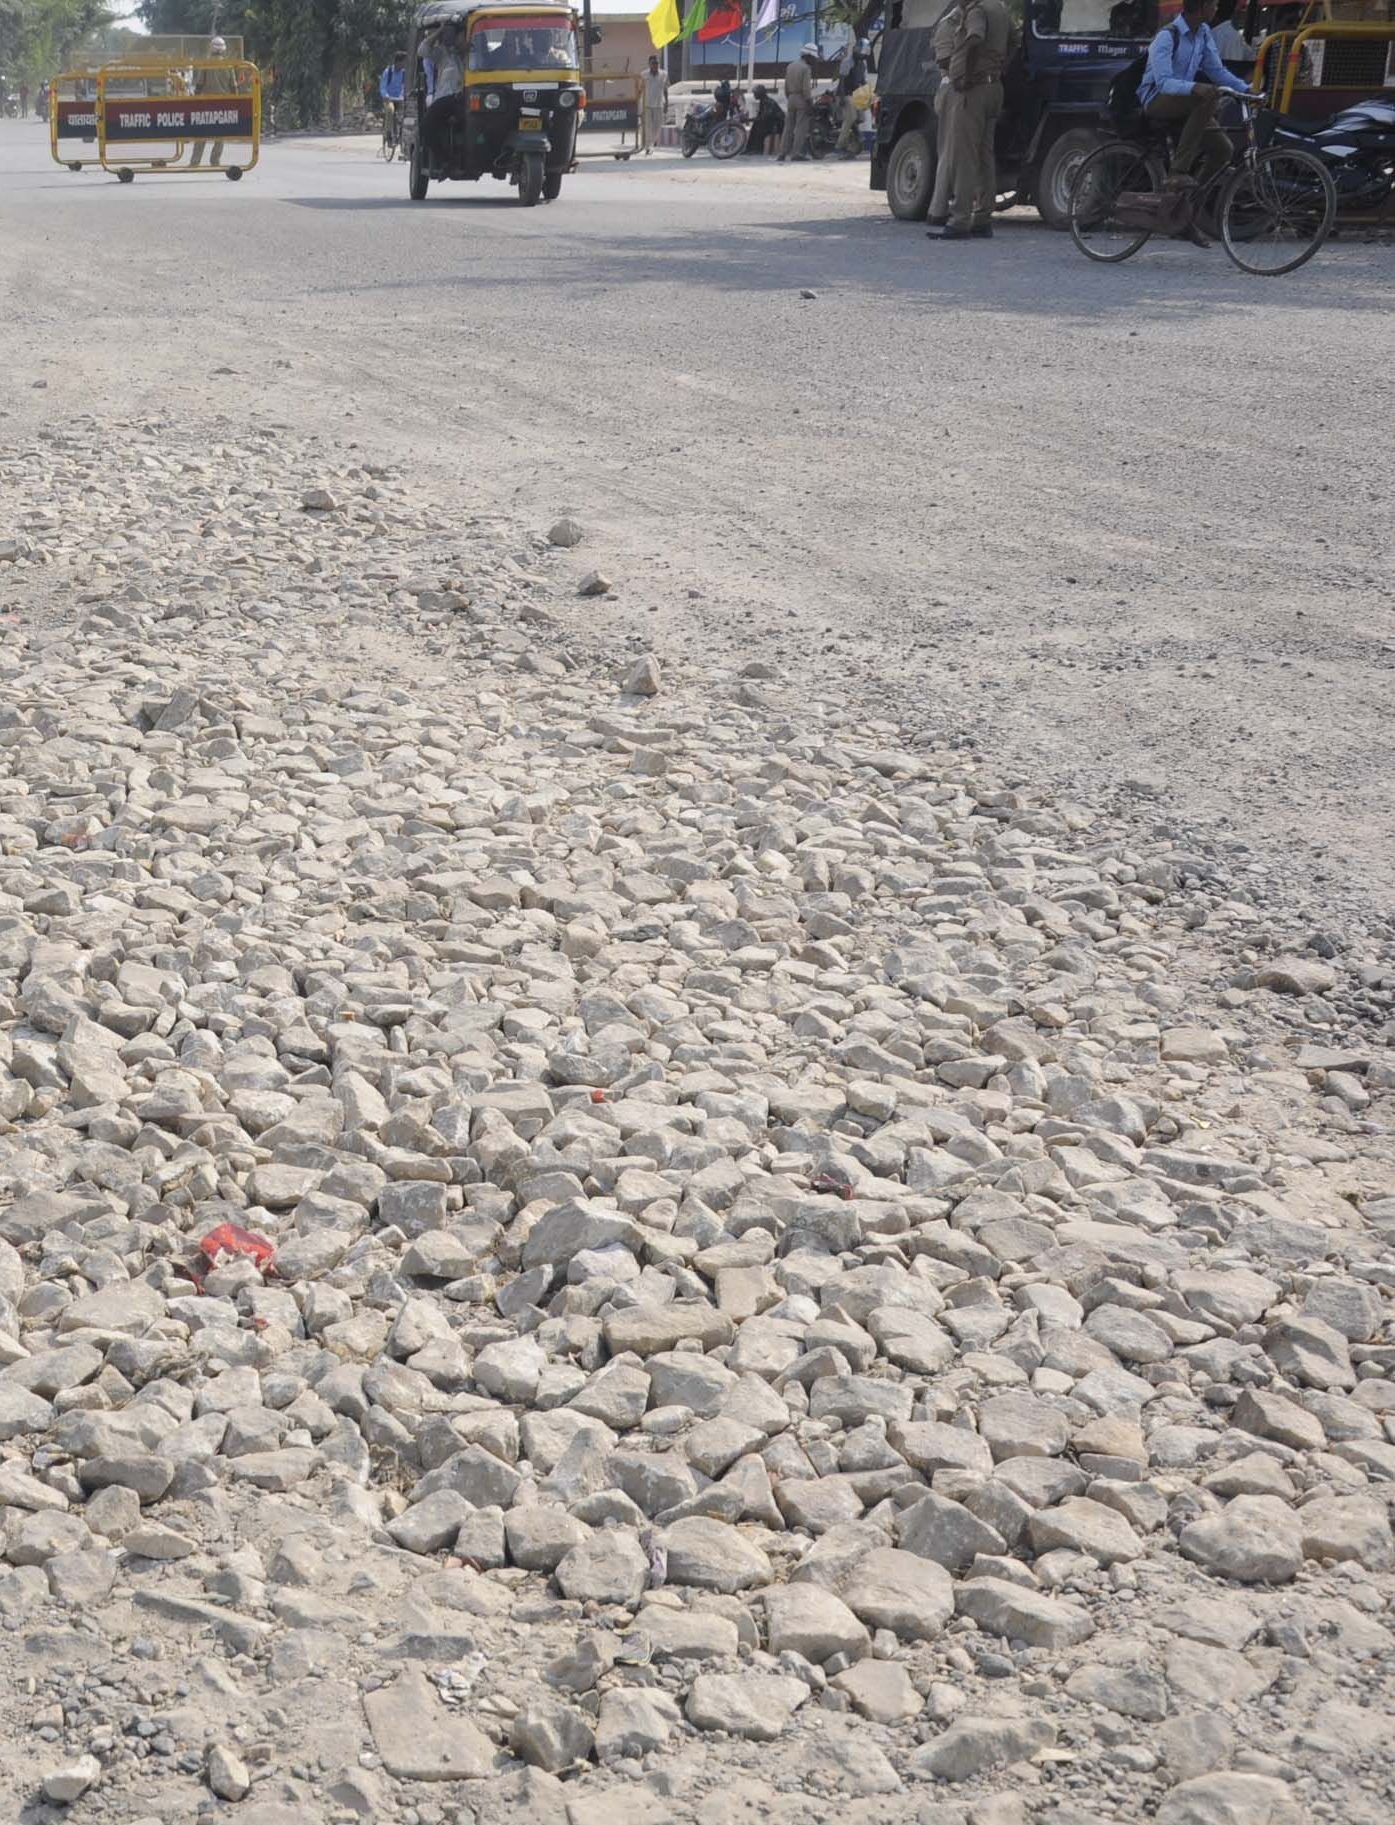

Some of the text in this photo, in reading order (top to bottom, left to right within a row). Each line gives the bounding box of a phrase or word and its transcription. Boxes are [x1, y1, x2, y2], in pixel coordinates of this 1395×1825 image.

[1058, 44, 1089, 54] TRAFFIC
[119, 110, 238, 128] TRAFFIC POLICE PRATAPGARH
